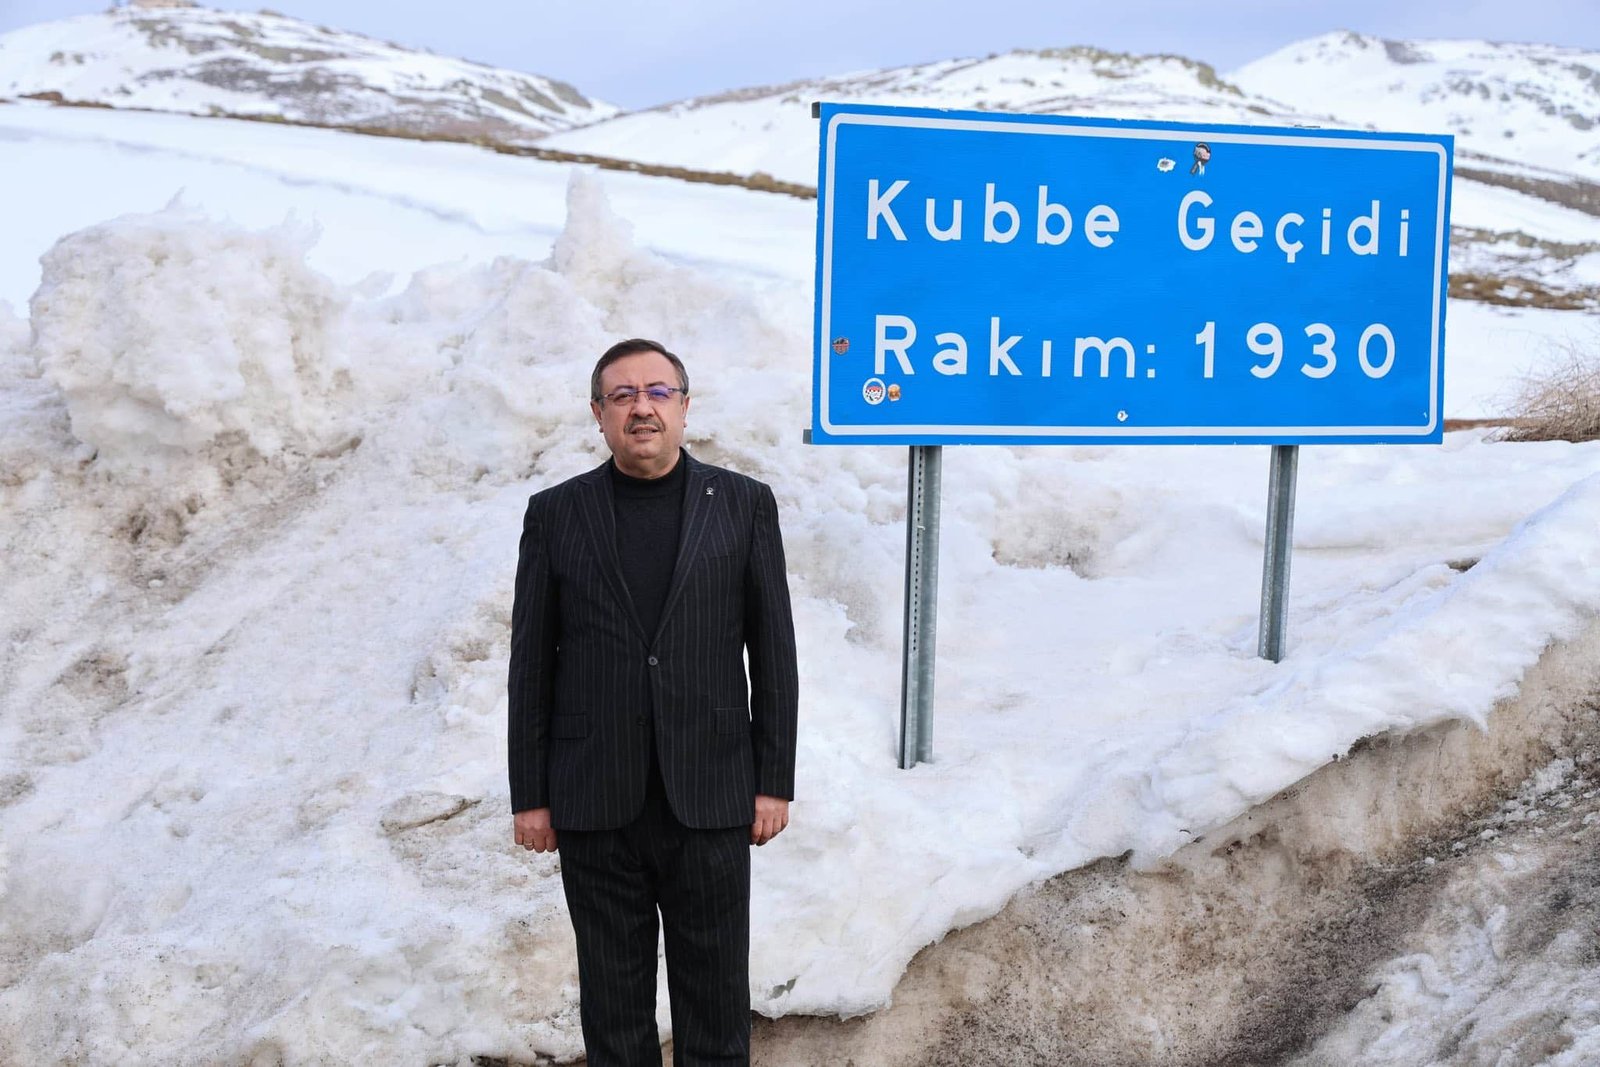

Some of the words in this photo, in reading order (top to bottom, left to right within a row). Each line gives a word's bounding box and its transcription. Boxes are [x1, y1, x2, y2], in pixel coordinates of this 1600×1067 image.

[867, 179, 1120, 248] Kubbe
[1178, 190, 1409, 263] Geçidi
[874, 314, 1155, 378] Rakım:
[1195, 321, 1395, 379] 1930
